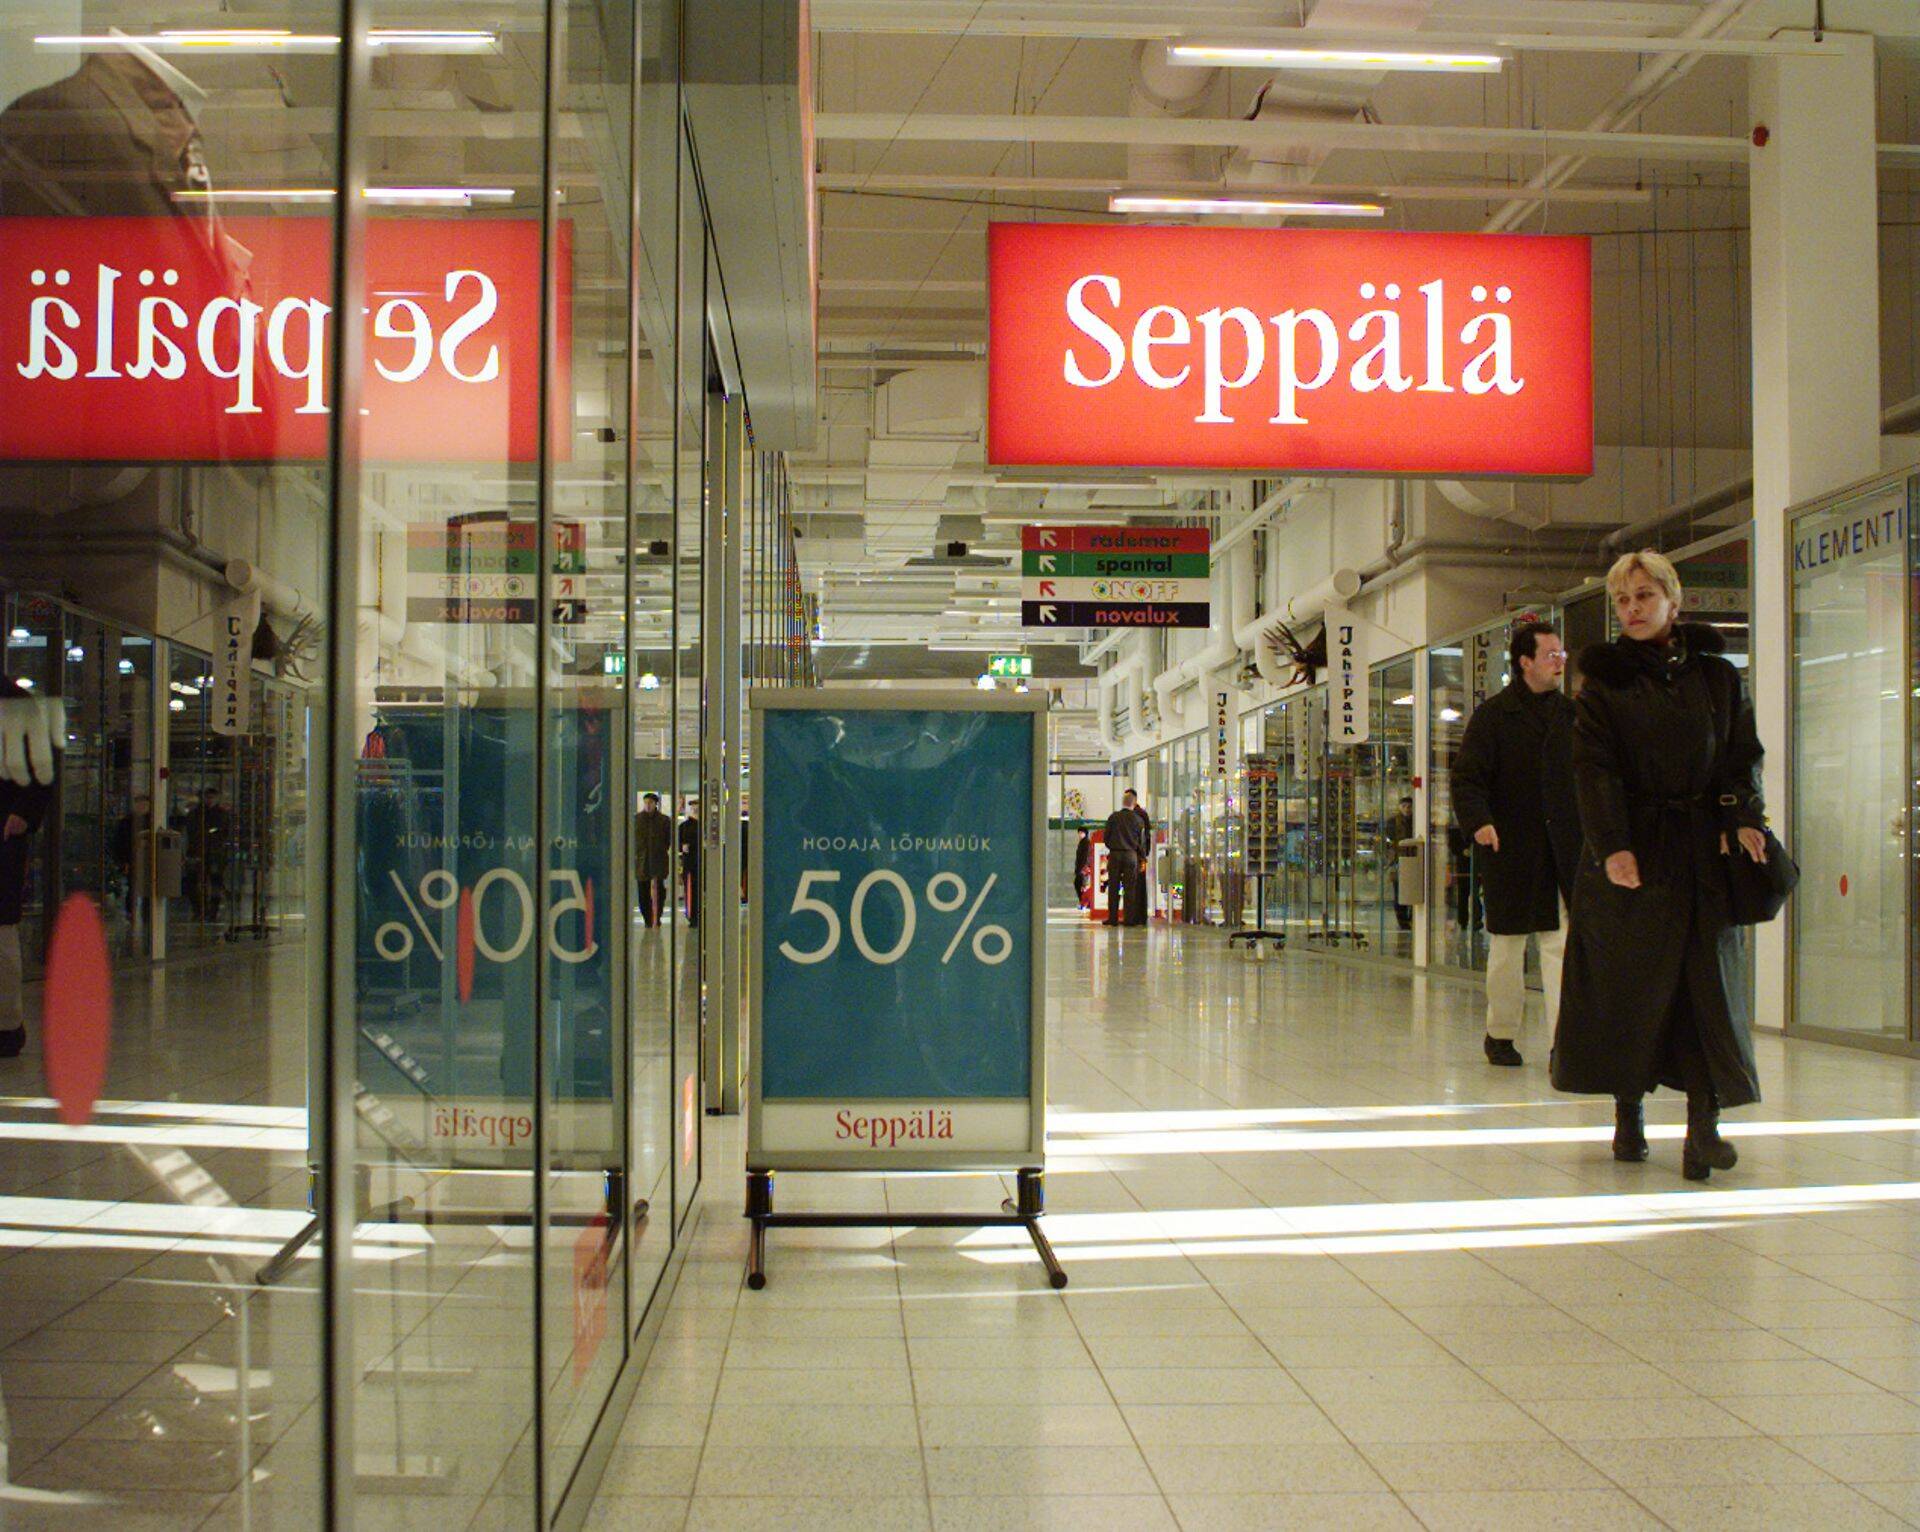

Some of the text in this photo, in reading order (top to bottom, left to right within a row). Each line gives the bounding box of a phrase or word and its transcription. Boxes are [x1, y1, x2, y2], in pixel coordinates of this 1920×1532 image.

[1063, 274, 1525, 425] Seppälä
[1794, 507, 1903, 571] KLEMENTI
[1096, 555, 1173, 577] spantal
[1091, 578, 1180, 601] ONOFF
[1095, 605, 1180, 624] novalux
[1339, 626, 1356, 735] Jahipaun
[802, 833, 992, 851] HOOAJA LÕPUMÜÜK
[779, 869, 1013, 965] 50%
[835, 1109, 954, 1148] Seppälä
